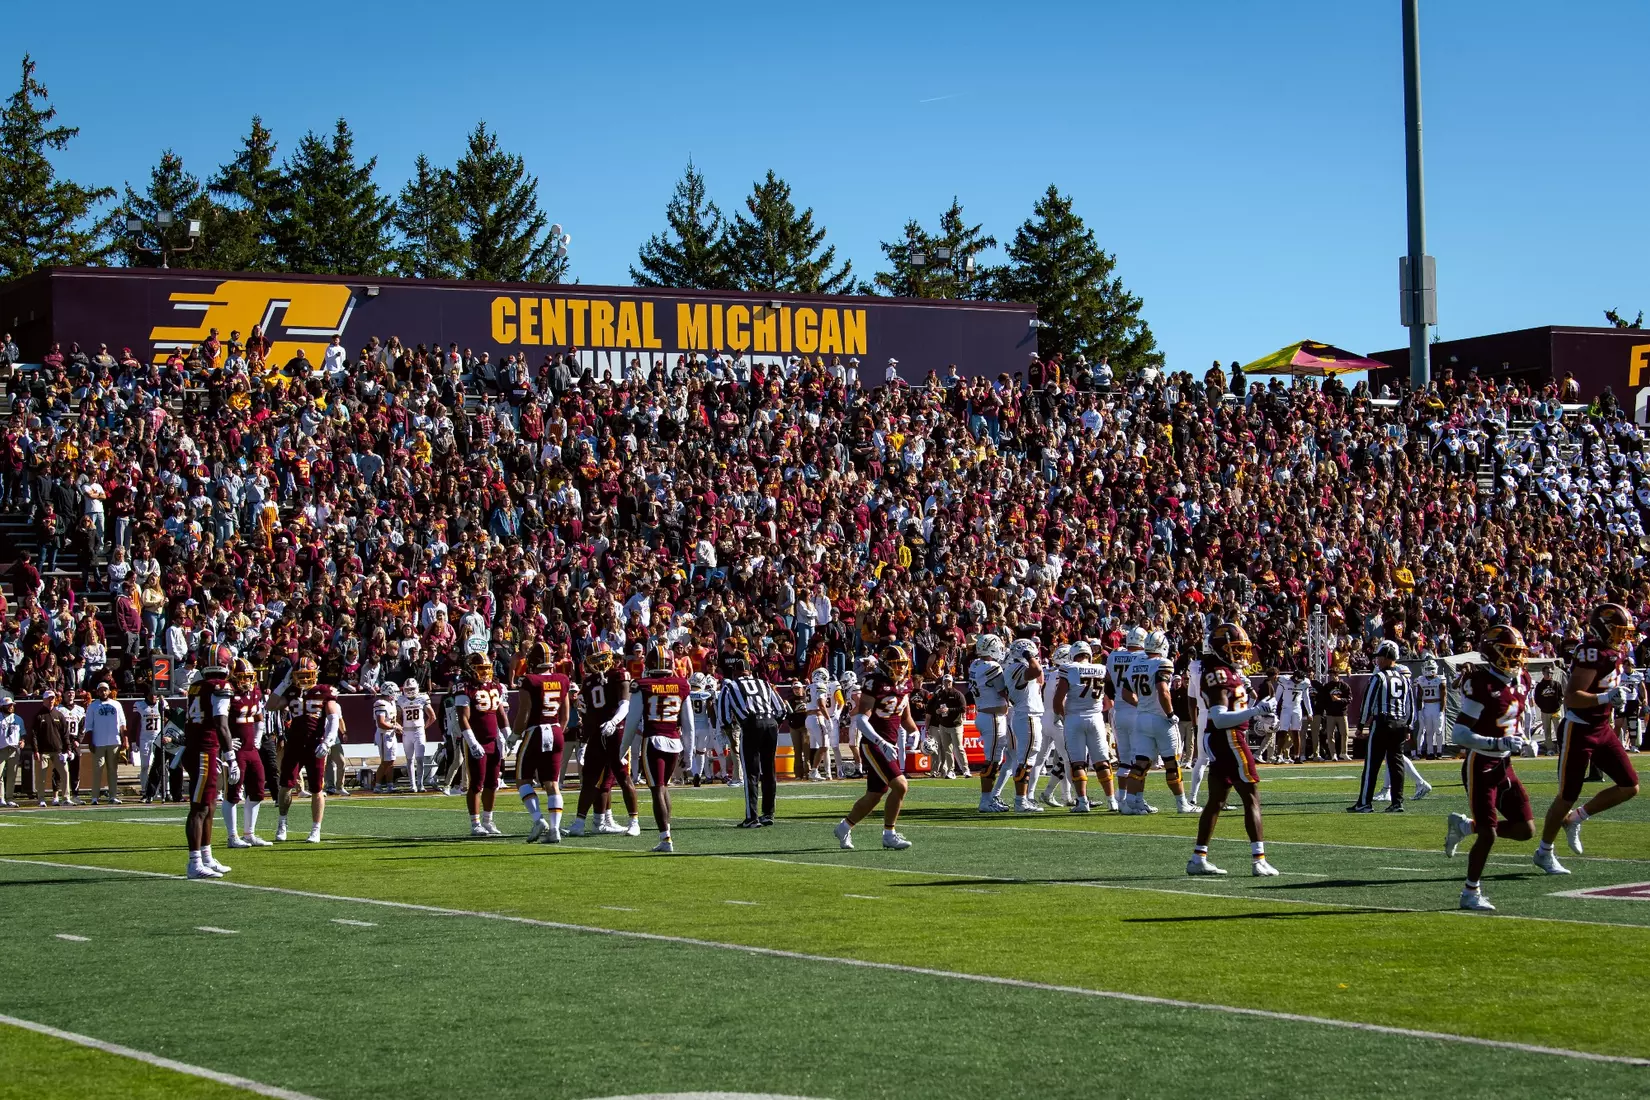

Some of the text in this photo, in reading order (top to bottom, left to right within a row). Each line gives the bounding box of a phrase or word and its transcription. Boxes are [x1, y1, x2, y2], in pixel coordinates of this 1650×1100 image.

[491, 296, 868, 355] CENTRAL MICHIGAN
[1576, 648, 1598, 662] 48
[154, 659, 170, 680] 2
[1205, 669, 1228, 687] 20
[741, 680, 759, 695] U
[1079, 677, 1105, 699] 75
[1131, 674, 1152, 696] 76
[1390, 678, 1403, 698] C
[475, 688, 501, 712] 92
[542, 691, 561, 717] 5
[591, 685, 606, 708] 0
[145, 717, 158, 731] 21
[405, 708, 420, 721] 28
[918, 757, 929, 769] G
